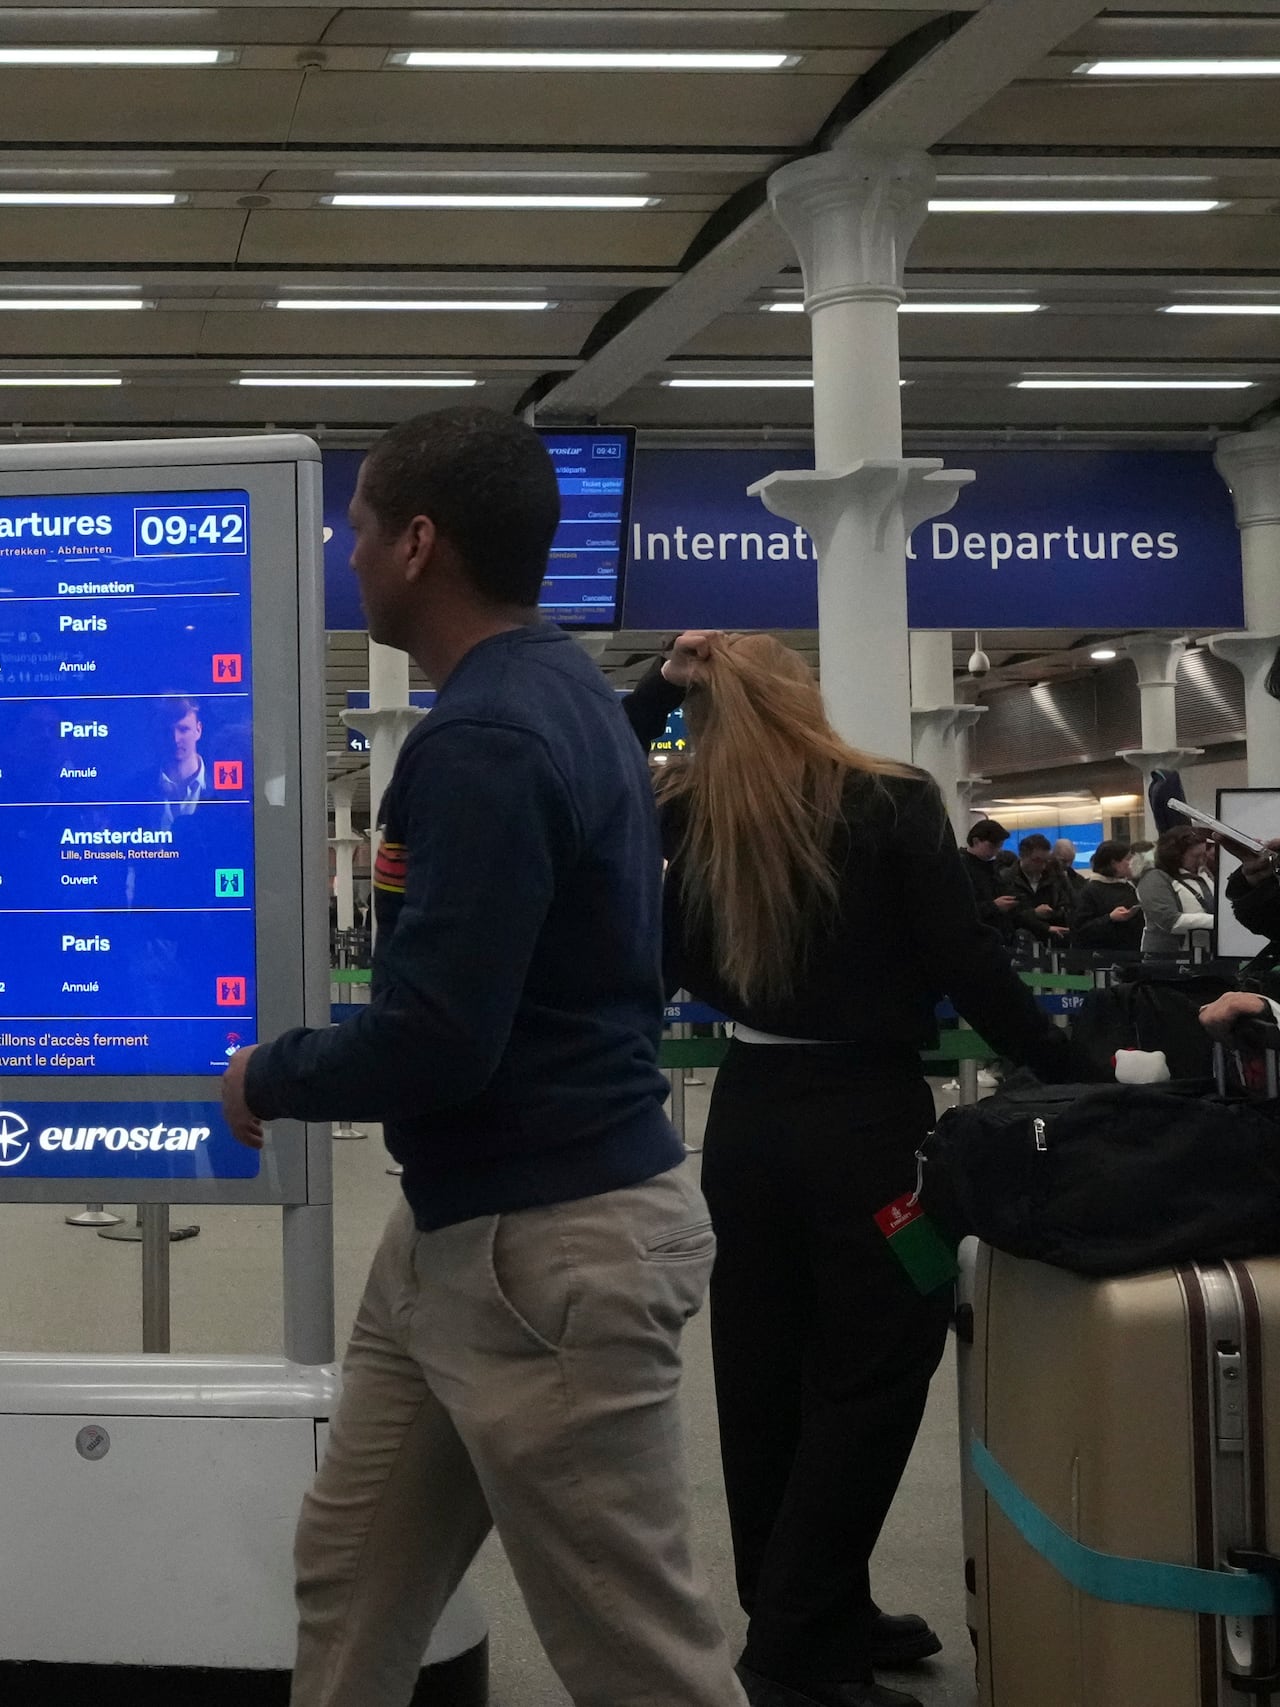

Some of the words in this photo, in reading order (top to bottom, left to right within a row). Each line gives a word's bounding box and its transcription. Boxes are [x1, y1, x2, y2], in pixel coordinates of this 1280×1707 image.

[140, 513, 243, 546] 09:42
[57, 545, 112, 555] Abfahrten
[932, 522, 1179, 570] Departures
[58, 580, 135, 595] Destination
[59, 614, 108, 632] Paris
[58, 660, 97, 672] Annulé
[60, 720, 109, 738] Paris
[656, 740, 672, 750] out
[59, 766, 98, 778] Annulé
[60, 827, 173, 845] Amsterdam
[60, 850, 83, 861] Lille,
[83, 849, 127, 860] Brussels,
[127, 848, 180, 859] Rotterdam
[60, 874, 98, 886] Ouvert
[62, 934, 111, 952] Paris
[61, 980, 100, 993] Annulé
[38, 1032, 91, 1047] d'accès
[92, 1033, 149, 1047] ferment
[35, 1053, 47, 1067] le
[49, 1052, 96, 1070] départ
[39, 1123, 210, 1151] eurostar
